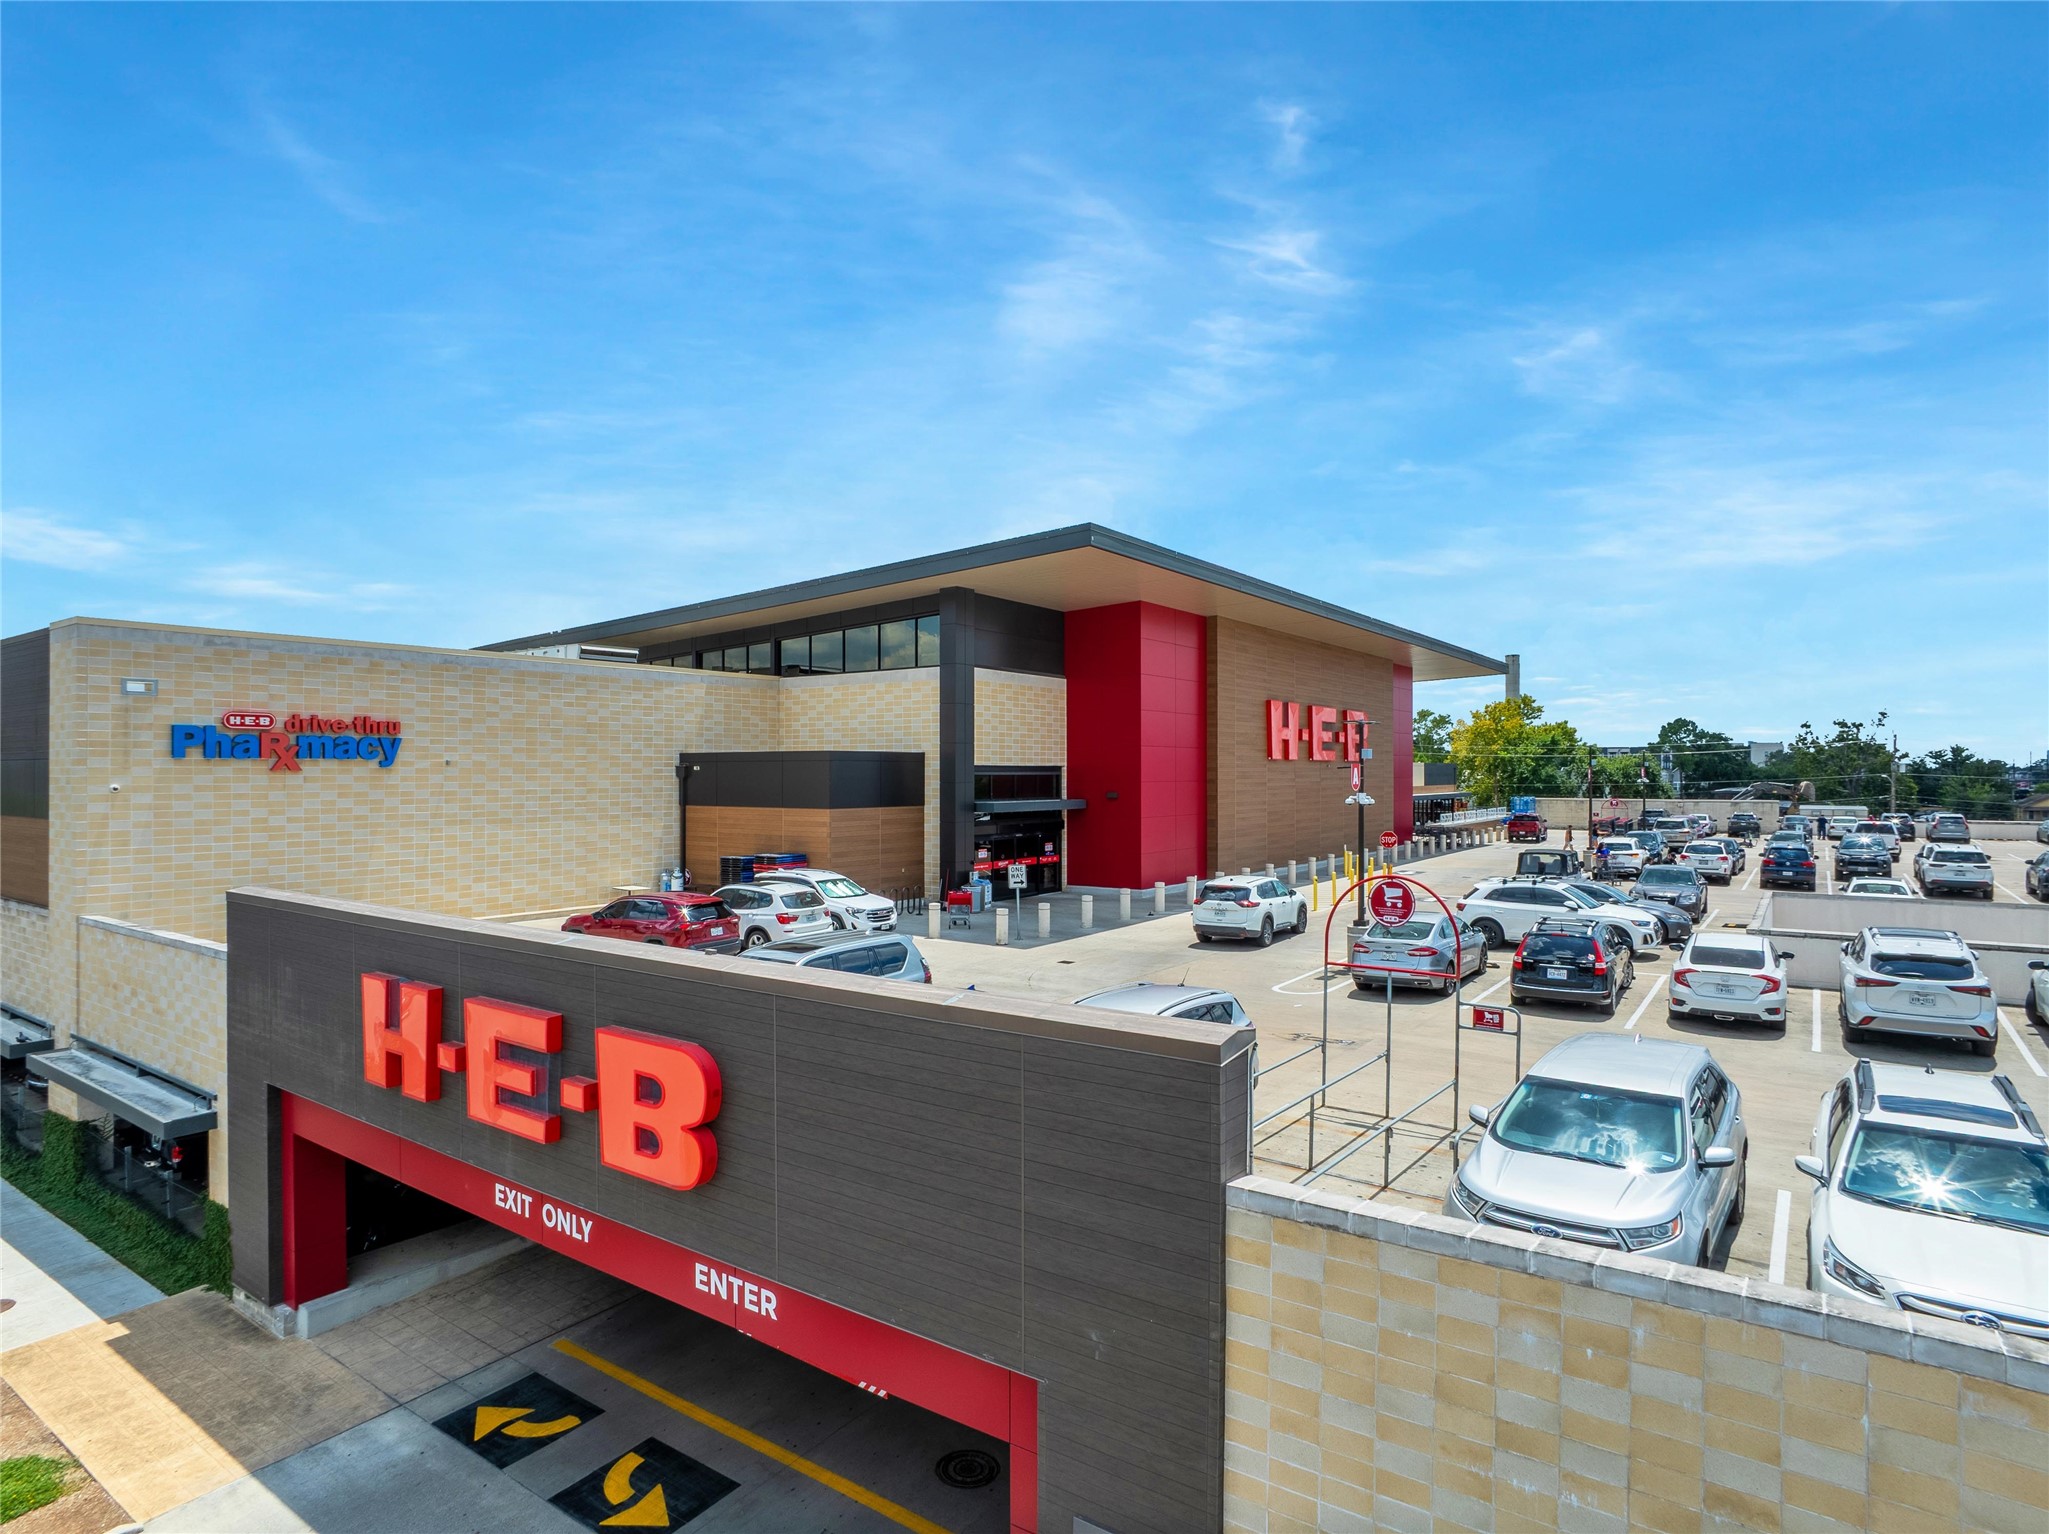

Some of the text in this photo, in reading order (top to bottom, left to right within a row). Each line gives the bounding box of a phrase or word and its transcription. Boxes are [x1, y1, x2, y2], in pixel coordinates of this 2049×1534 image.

[284, 714, 401, 735] drive-thru
[1352, 767, 1359, 785] A
[1381, 836, 1397, 844] STOP
[495, 1183, 593, 1243] EXIT ONLY
[695, 1262, 777, 1320] ENTER
